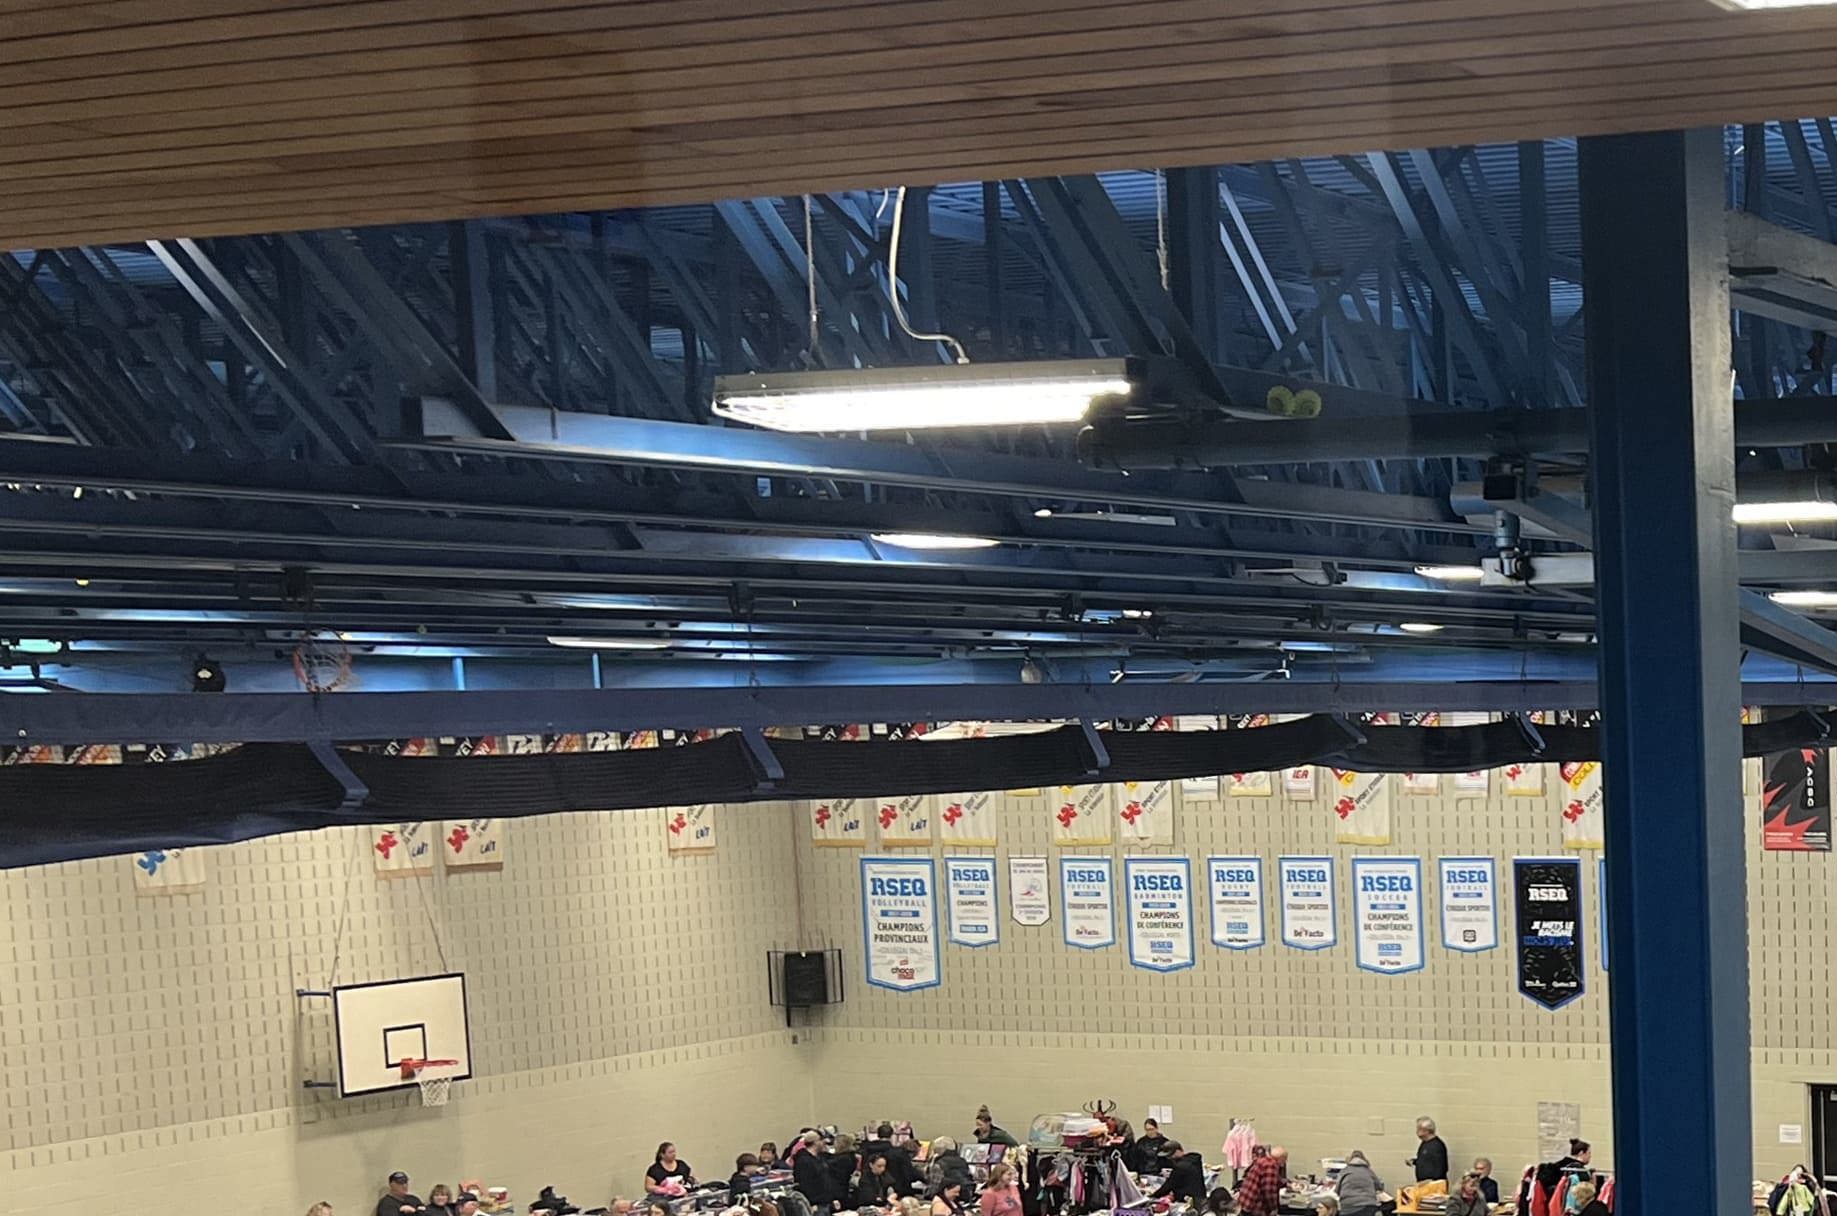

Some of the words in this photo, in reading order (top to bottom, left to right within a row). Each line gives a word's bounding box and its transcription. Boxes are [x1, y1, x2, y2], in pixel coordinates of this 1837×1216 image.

[952, 869, 990, 882] RSEQ
[1067, 870, 1106, 882] RSEQ
[1215, 870, 1255, 882] RSEQ
[1286, 870, 1327, 882] RSEQ
[1446, 870, 1488, 883] RSEQ
[870, 877, 927, 896] RSEQ
[1133, 875, 1183, 891] RSEQ
[1361, 876, 1413, 892] RSEQ
[1528, 888, 1568, 901] RSEQ
[1367, 913, 1409, 921] CHAMPIONS
[877, 922, 925, 932] CHAMPIONS
[874, 933, 929, 944] PROVINCIAUX
